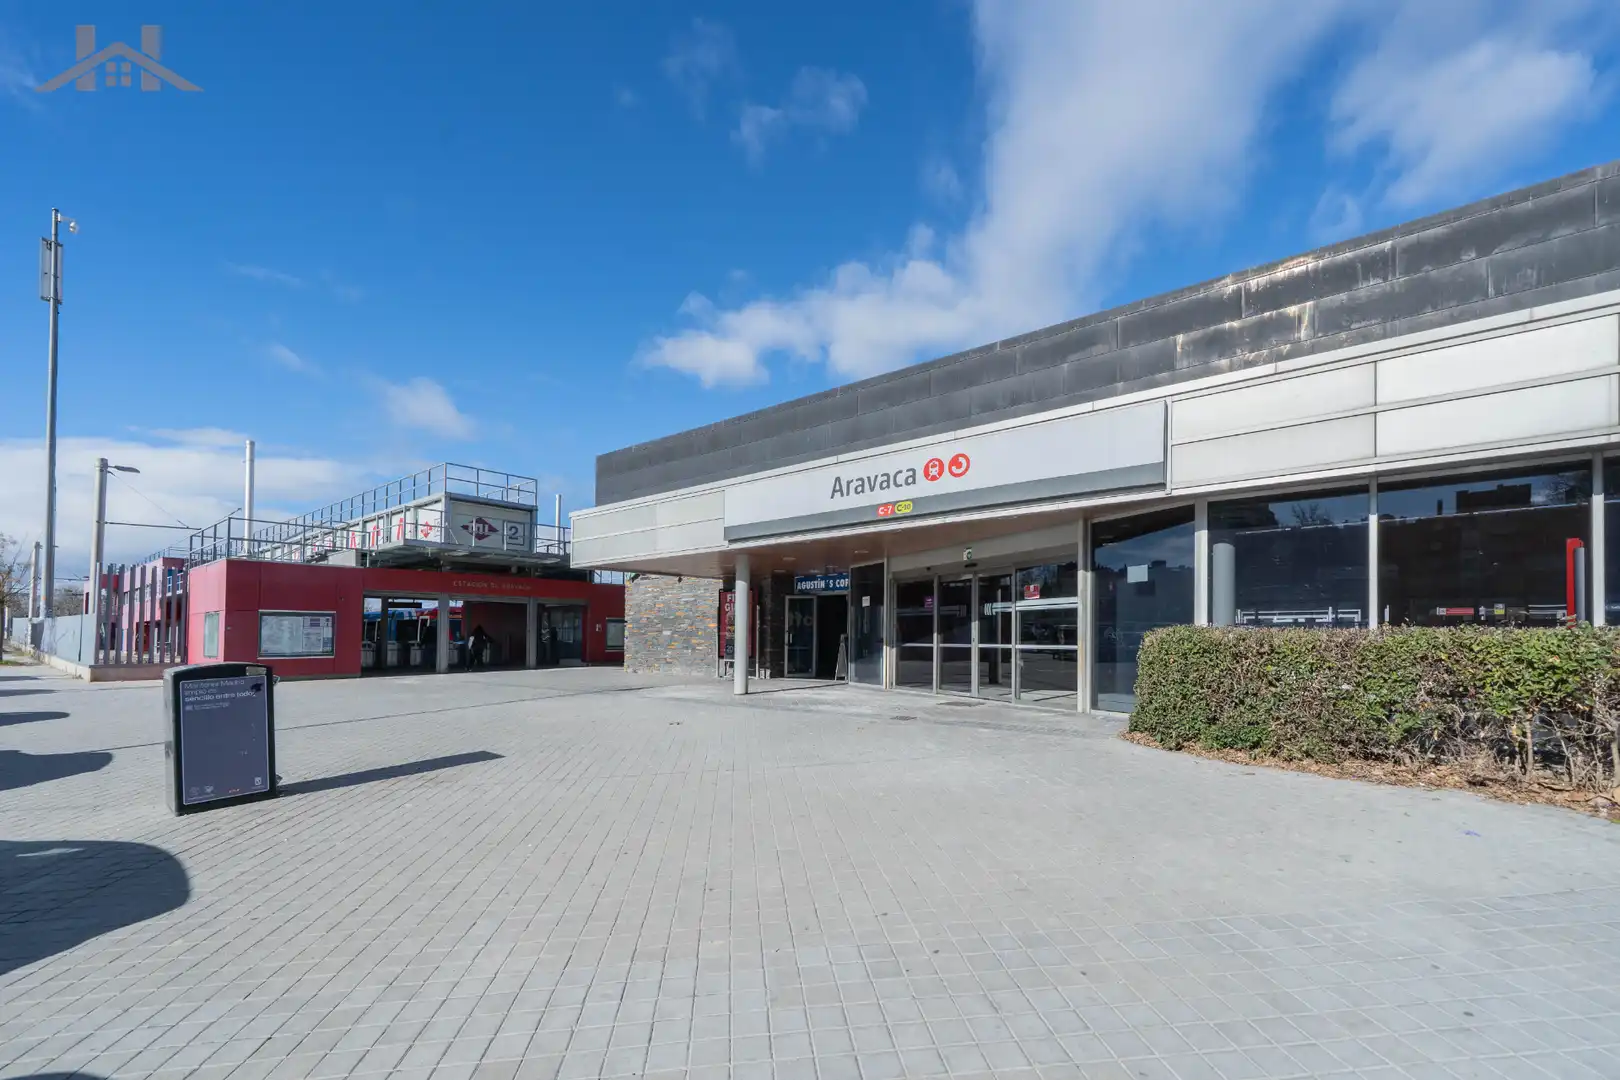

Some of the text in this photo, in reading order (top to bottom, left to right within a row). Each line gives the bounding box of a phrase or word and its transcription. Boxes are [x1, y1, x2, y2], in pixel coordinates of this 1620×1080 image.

[829, 467, 917, 500] Aravaca
[878, 502, 912, 516] C-7 C-10
[508, 525, 519, 541] 2
